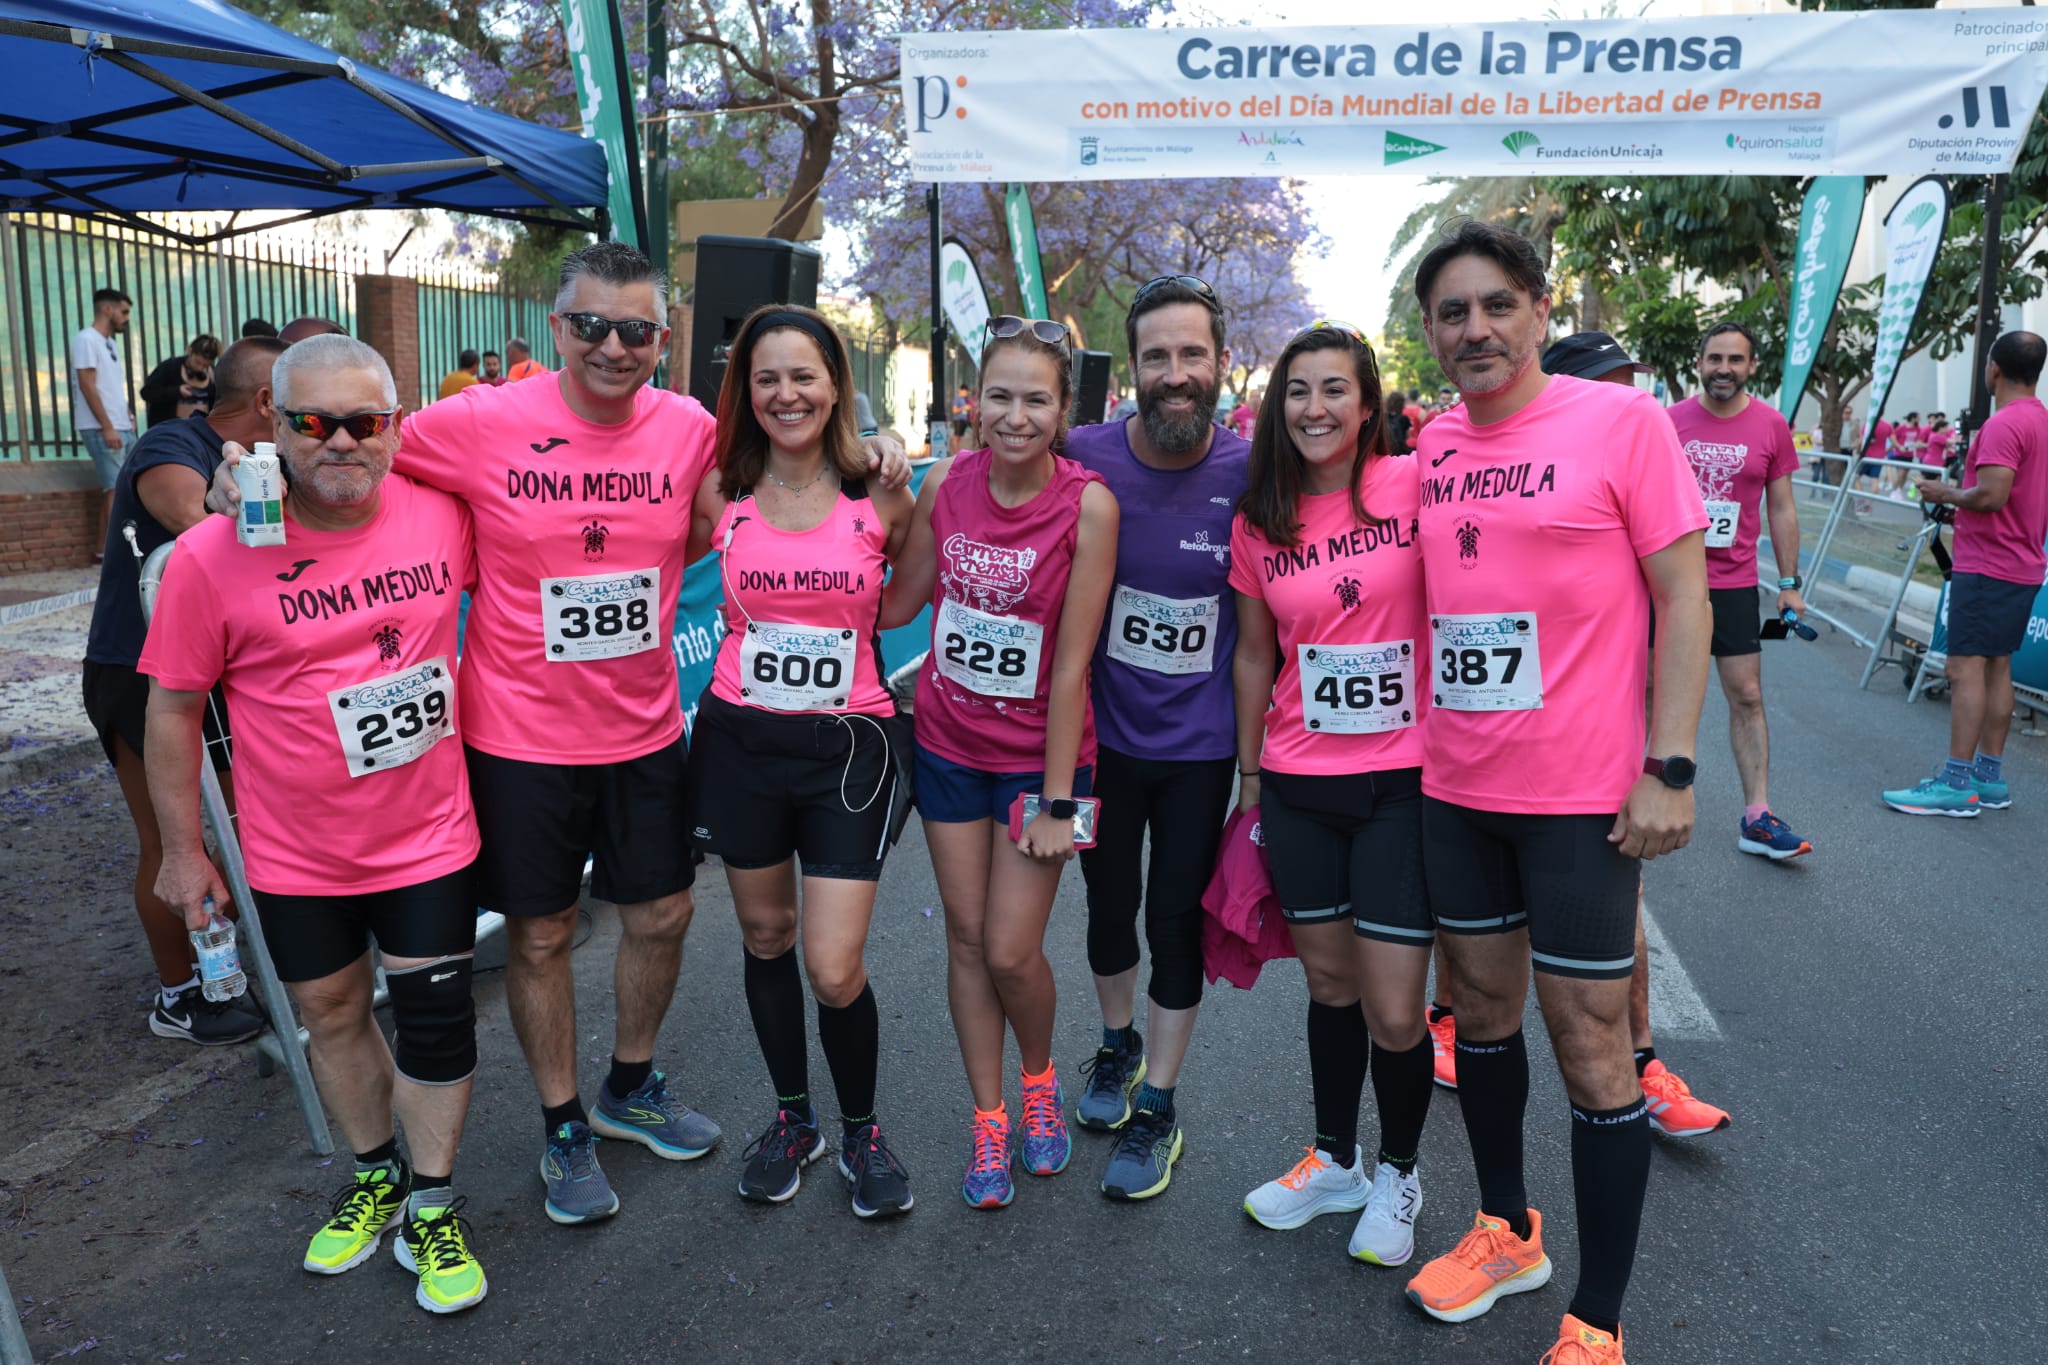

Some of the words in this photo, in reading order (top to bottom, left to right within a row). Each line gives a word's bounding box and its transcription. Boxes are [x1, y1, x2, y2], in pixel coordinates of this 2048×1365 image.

[907, 48, 990, 60] Organizadora:
[1177, 37, 1376, 79] Carrera
[1394, 32, 1462, 76] de
[1480, 31, 1526, 74] la
[1545, 31, 1742, 74] Prensa
[1081, 101, 1128, 119] con
[1136, 97, 1232, 119] motivo
[1239, 95, 1281, 117] del
[1290, 93, 1333, 117] Día
[1342, 92, 1452, 117] Mundial
[1461, 92, 1496, 115] de
[1505, 92, 1529, 115] la
[1538, 90, 1664, 114] Libertad
[1672, 90, 1709, 113] de
[1718, 88, 1822, 111] Prensa
[1908, 138, 1973, 150] Diputación
[1936, 151, 1951, 162] de
[1954, 151, 2002, 164] Málaga
[507, 468, 573, 504] DONA
[582, 467, 673, 505] MÉDULA
[947, 537, 1020, 566] Carrera
[1179, 539, 1231, 552] RetoDrave
[1263, 543, 1320, 584] DONA
[740, 569, 788, 593] DONA
[794, 567, 865, 595] MÉDULA
[956, 554, 1020, 581] Prensa
[278, 583, 358, 625] DONA
[361, 560, 453, 609] MÉDULA
[560, 598, 649, 639] 388
[1123, 614, 1207, 654] 630
[753, 651, 842, 689] 600
[945, 632, 1027, 678] 228
[1441, 647, 1523, 686] 387
[1314, 672, 1404, 709] 465
[356, 690, 447, 753] 239
